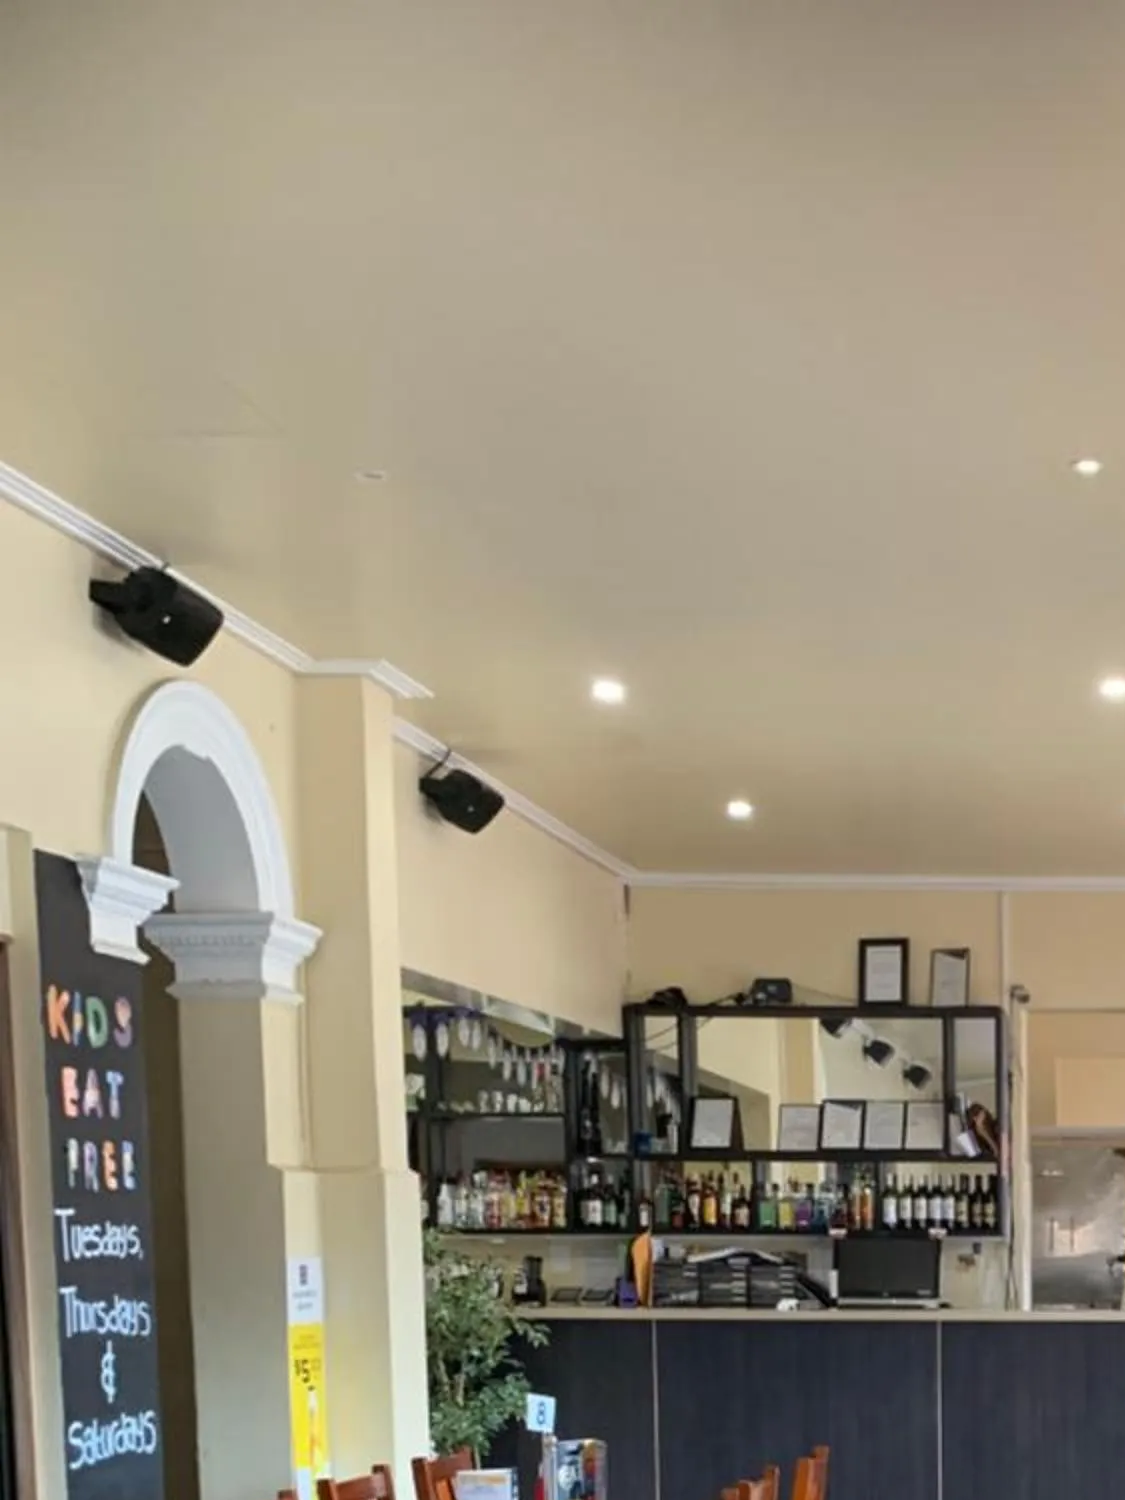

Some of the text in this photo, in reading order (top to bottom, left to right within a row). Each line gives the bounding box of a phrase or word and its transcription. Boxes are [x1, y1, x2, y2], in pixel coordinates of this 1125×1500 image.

[47, 984, 133, 1048] KIDS
[61, 1066, 124, 1120] EAT
[64, 1138, 136, 1192] FREE
[68, 1410, 157, 1470] Saturdays
